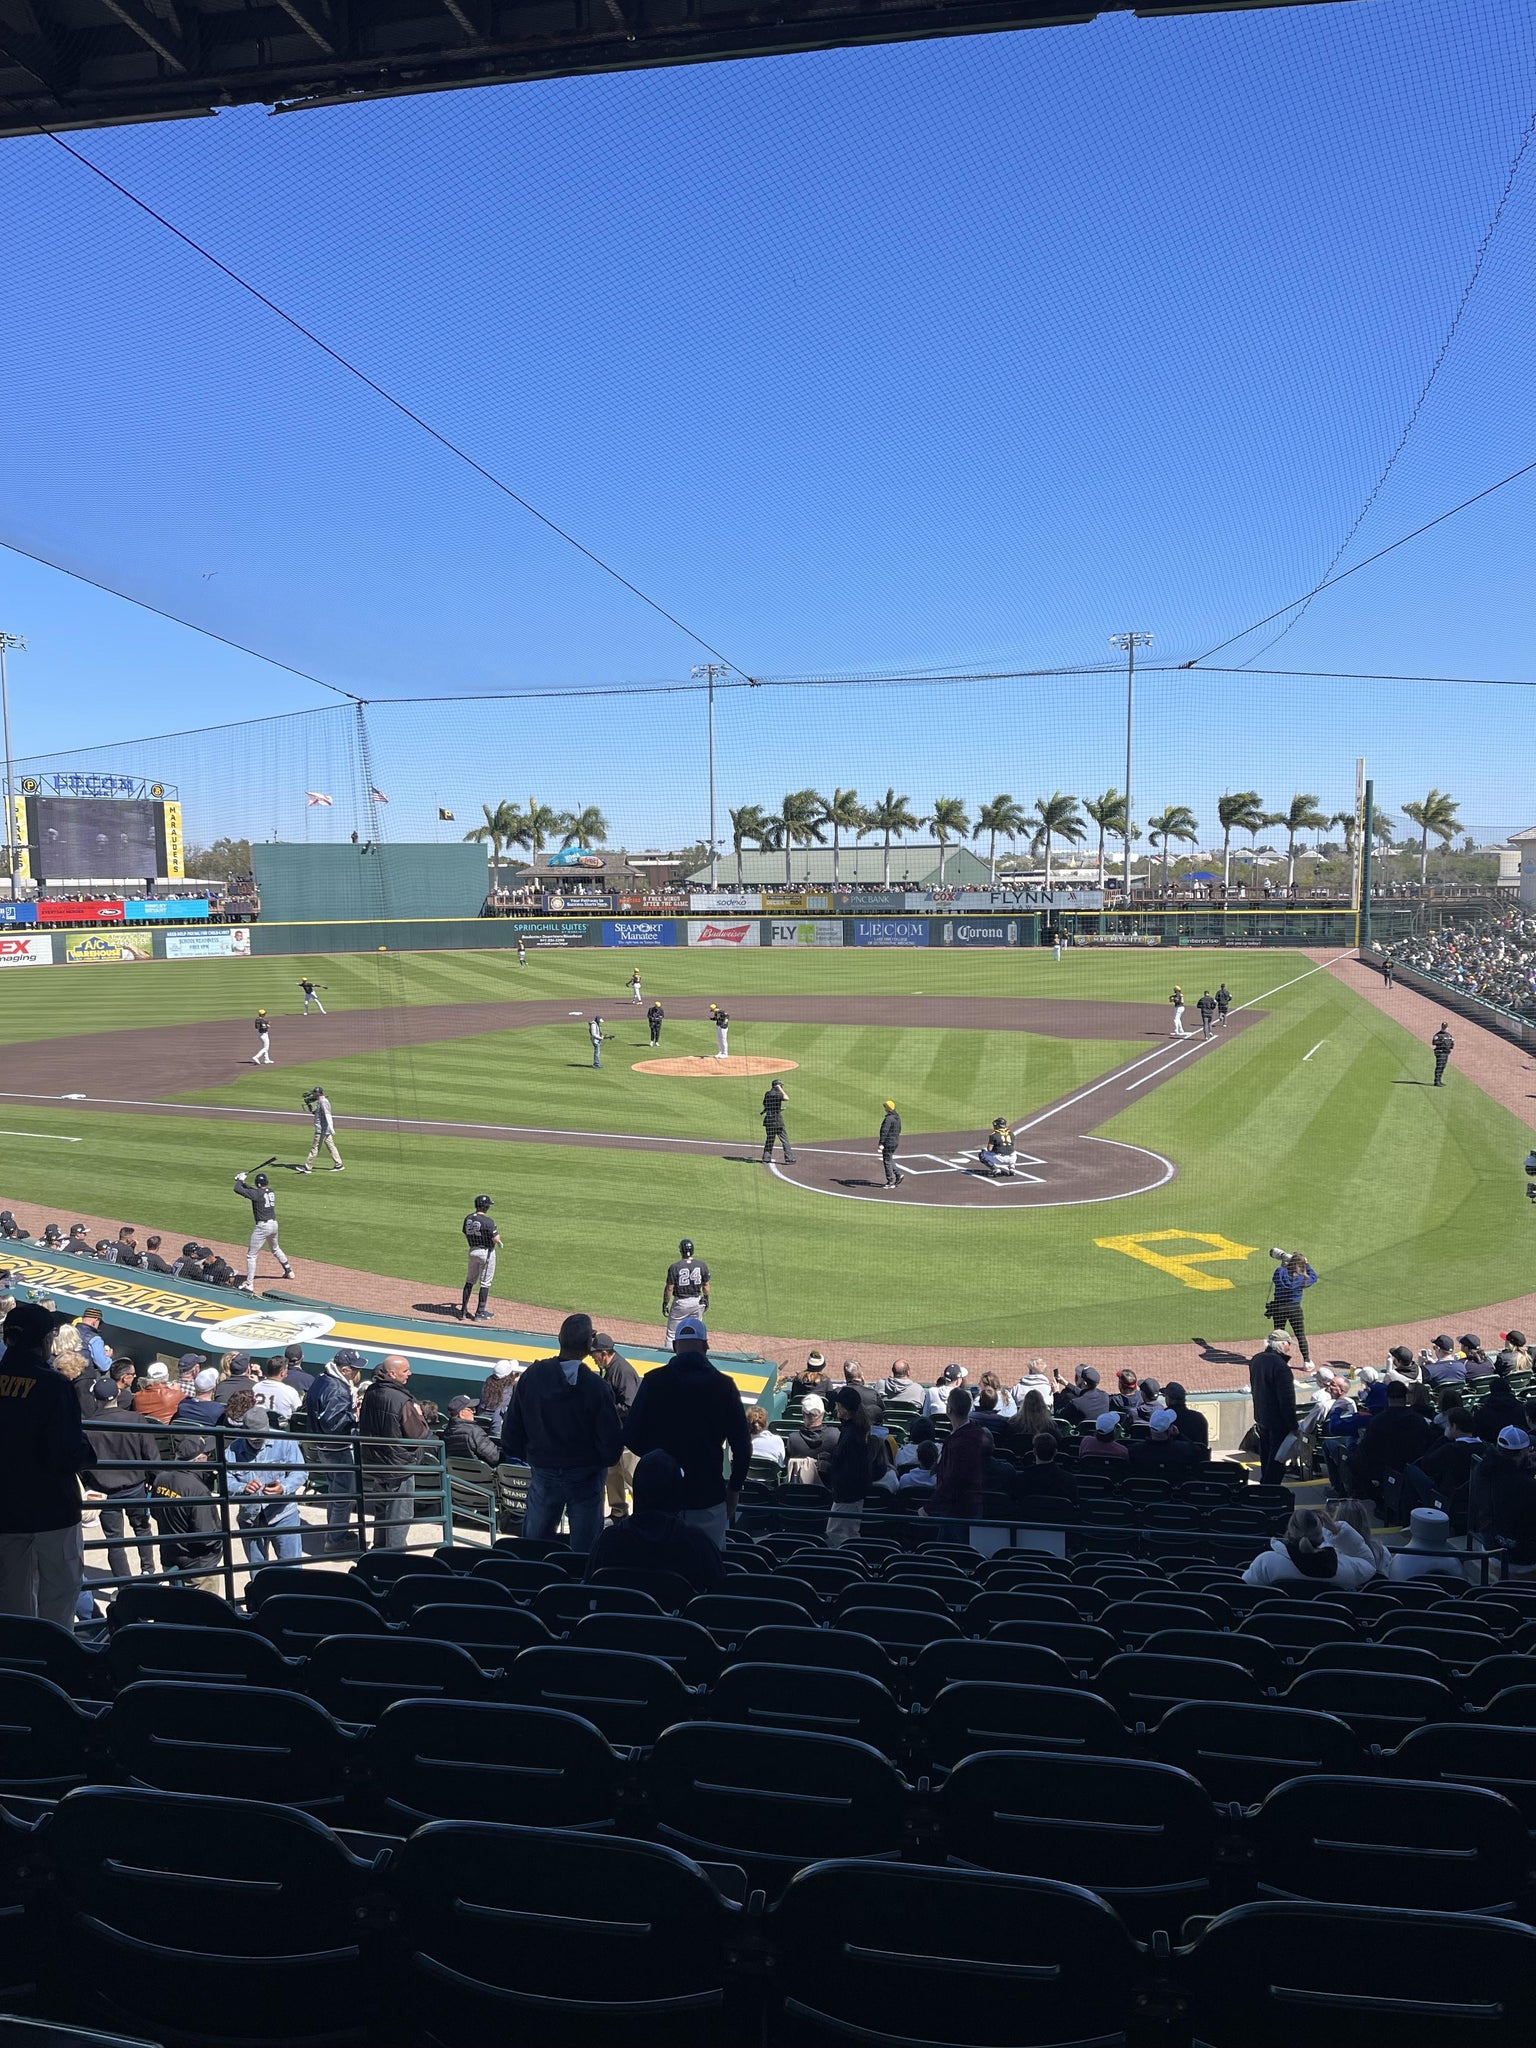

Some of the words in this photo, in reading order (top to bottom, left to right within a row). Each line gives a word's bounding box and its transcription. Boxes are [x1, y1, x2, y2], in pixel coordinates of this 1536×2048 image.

[169, 806, 179, 873] MARAUDERS
[933, 893, 955, 901] COX
[990, 892, 1054, 904] FLYNN
[615, 923, 663, 932] SEAPORT
[702, 928, 746, 938] Budweiser
[772, 926, 797, 940] FLY
[957, 926, 1003, 941] Corona
[621, 932, 658, 940] Manatee
[84, 941, 105, 950] A/C
[72, 948, 121, 958] WAREHOUSE
[264, 1192, 275, 1207] 19
[465, 1219, 481, 1236] 22
[1093, 1229, 1259, 1291] P
[679, 1267, 701, 1286] 24
[0, 1254, 97, 1293] COM
[92, 1281, 229, 1322] PARK
